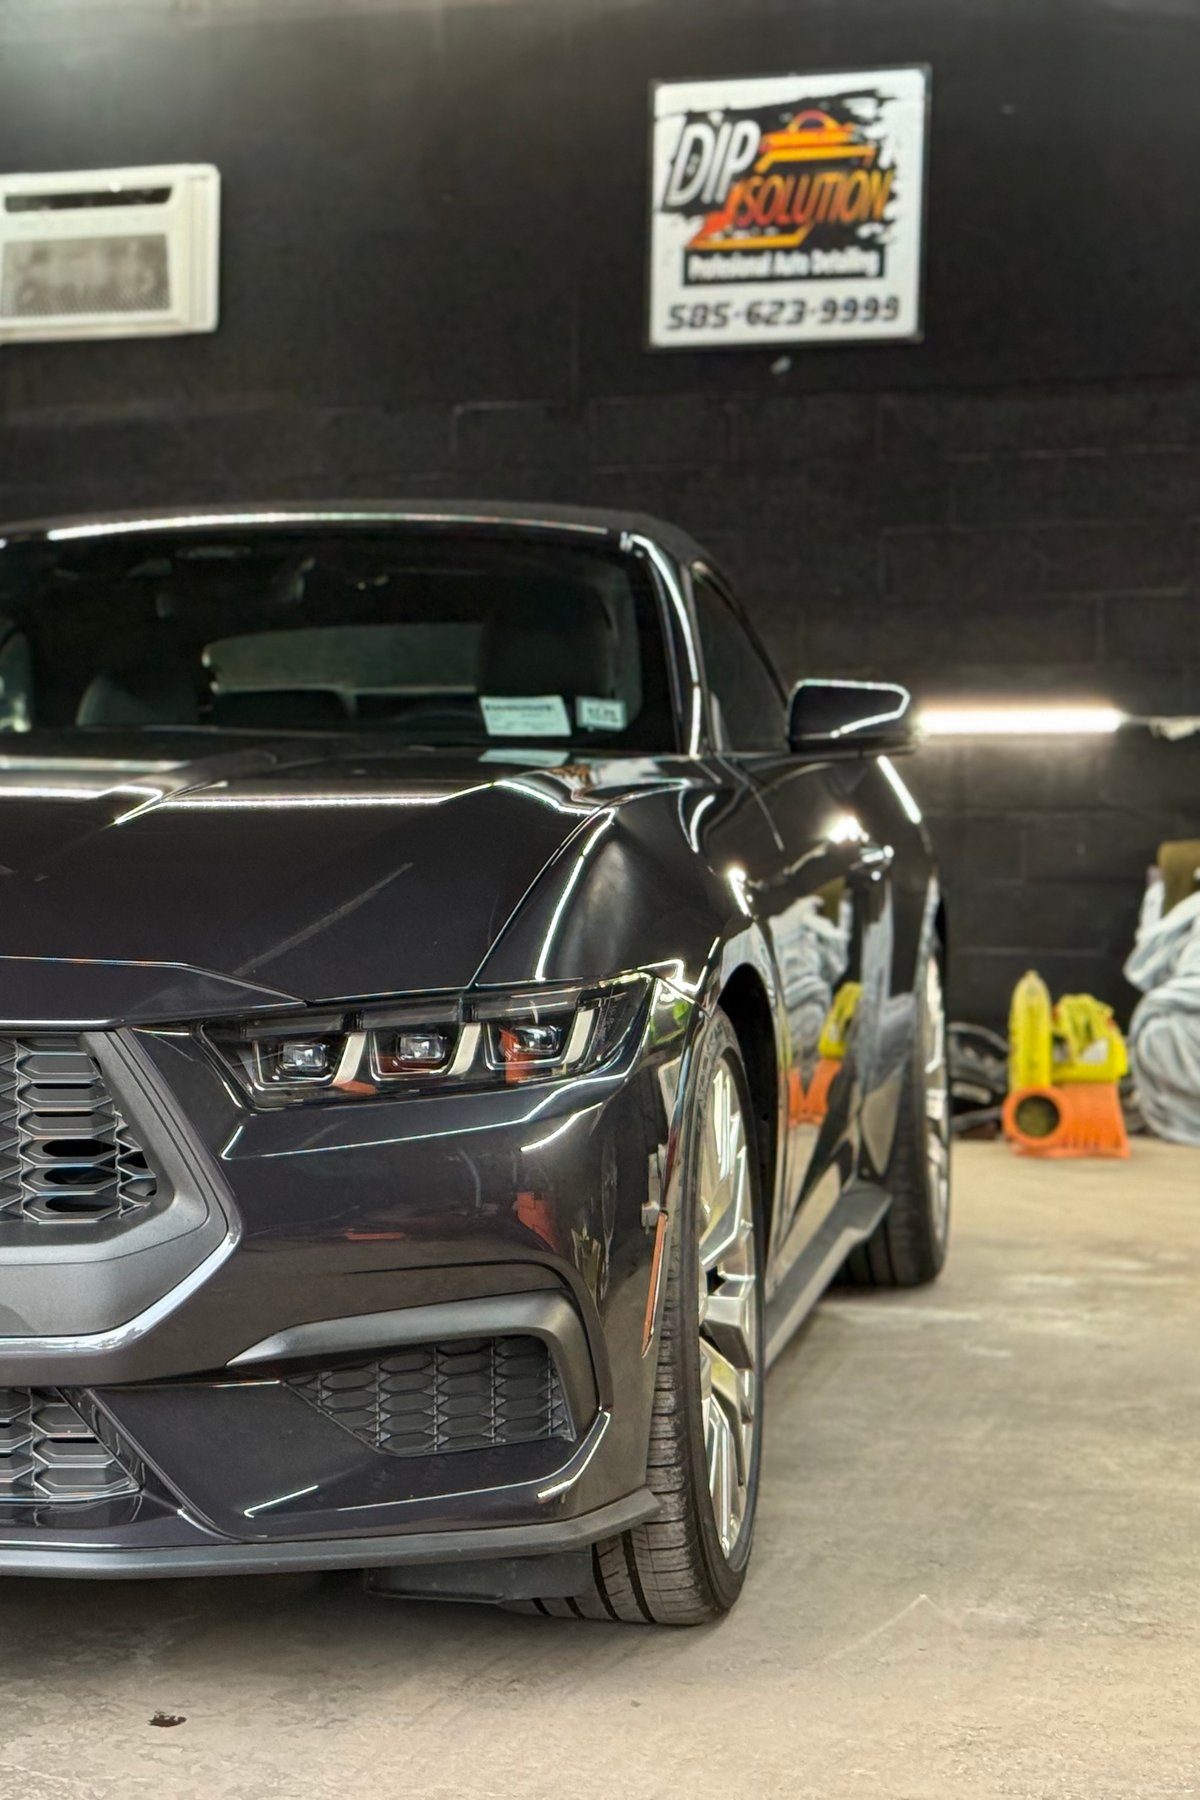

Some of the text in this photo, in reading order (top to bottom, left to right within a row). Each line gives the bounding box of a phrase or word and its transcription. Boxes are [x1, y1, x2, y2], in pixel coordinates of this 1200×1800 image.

[664, 116, 762, 207] DIP
[737, 170, 894, 227] SOLUTION
[667, 296, 900, 331] 585-623-9999
